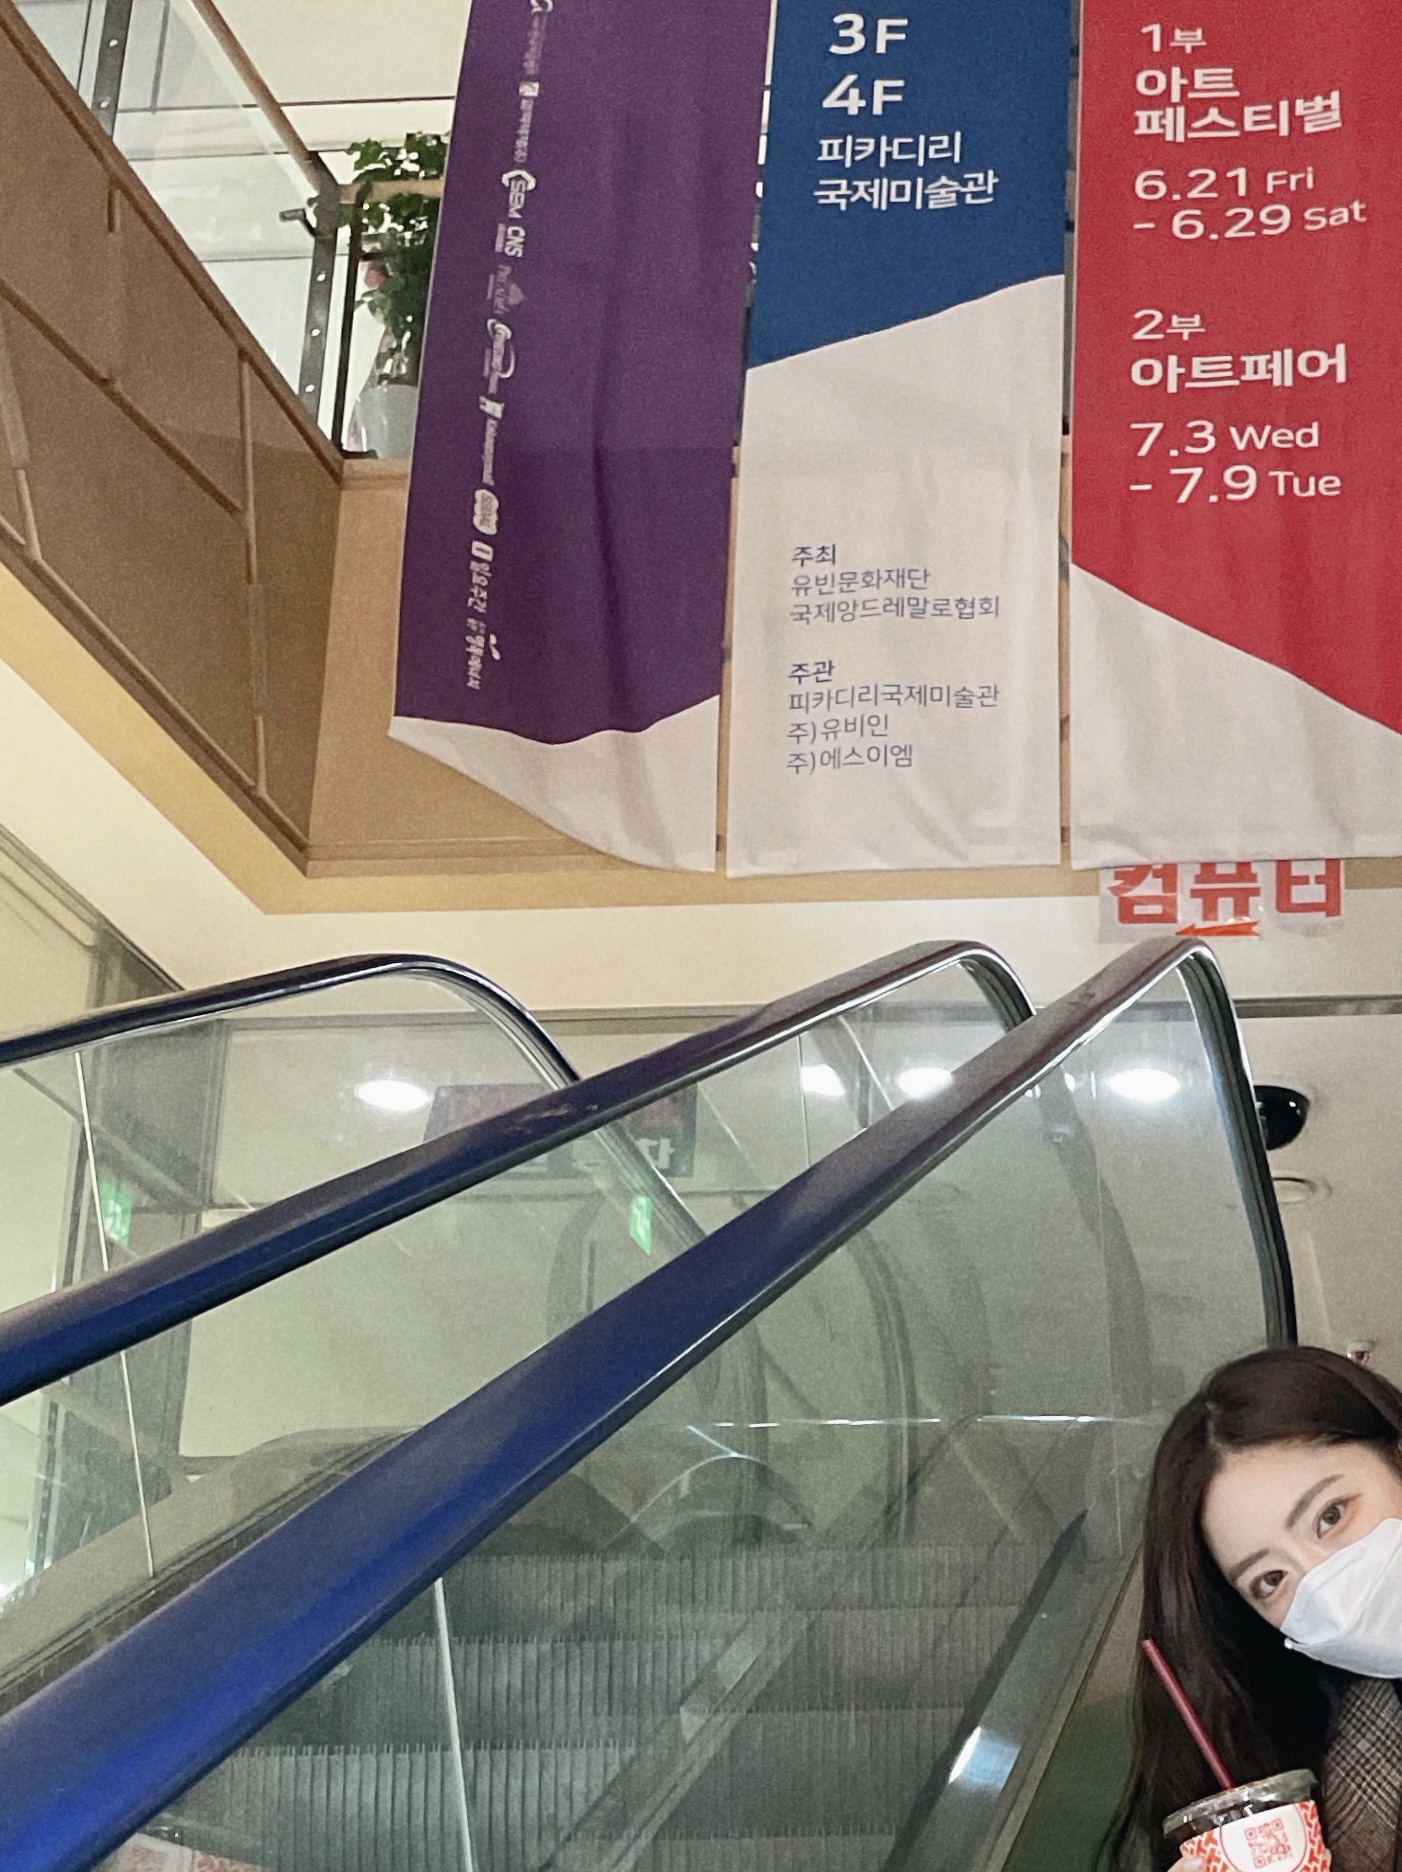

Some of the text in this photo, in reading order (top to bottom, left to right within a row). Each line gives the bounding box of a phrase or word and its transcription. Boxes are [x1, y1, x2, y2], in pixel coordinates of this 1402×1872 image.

[829, 13, 909, 55] 3F
[1140, 23, 1207, 53] 1부
[822, 74, 905, 115] 4F
[1136, 66, 1240, 103] 아트
[1134, 90, 1342, 142] 페스티벌
[817, 131, 962, 168] 피카디리
[813, 169, 999, 211] 국제미술관
[1135, 166, 1314, 200] 6.21 Fri
[1172, 204, 1292, 240] 6.29
[1304, 199, 1367, 231] Sat
[504, 226, 526, 258] CNS
[1132, 309, 1206, 340] 2부
[1131, 343, 1347, 393] 아트페어
[1130, 420, 1320, 457] 7.3 Wed
[1169, 464, 1257, 503] 7.9
[1268, 471, 1342, 497] Tue
[792, 544, 837, 567] 주최
[791, 567, 931, 597] 유빈문화재단
[790, 596, 1000, 625] 국제앙드레말로협회
[788, 660, 835, 685] 주관
[788, 684, 1000, 714] 피카디리국제미술관
[1107, 858, 1342, 924] 컴퓨터
